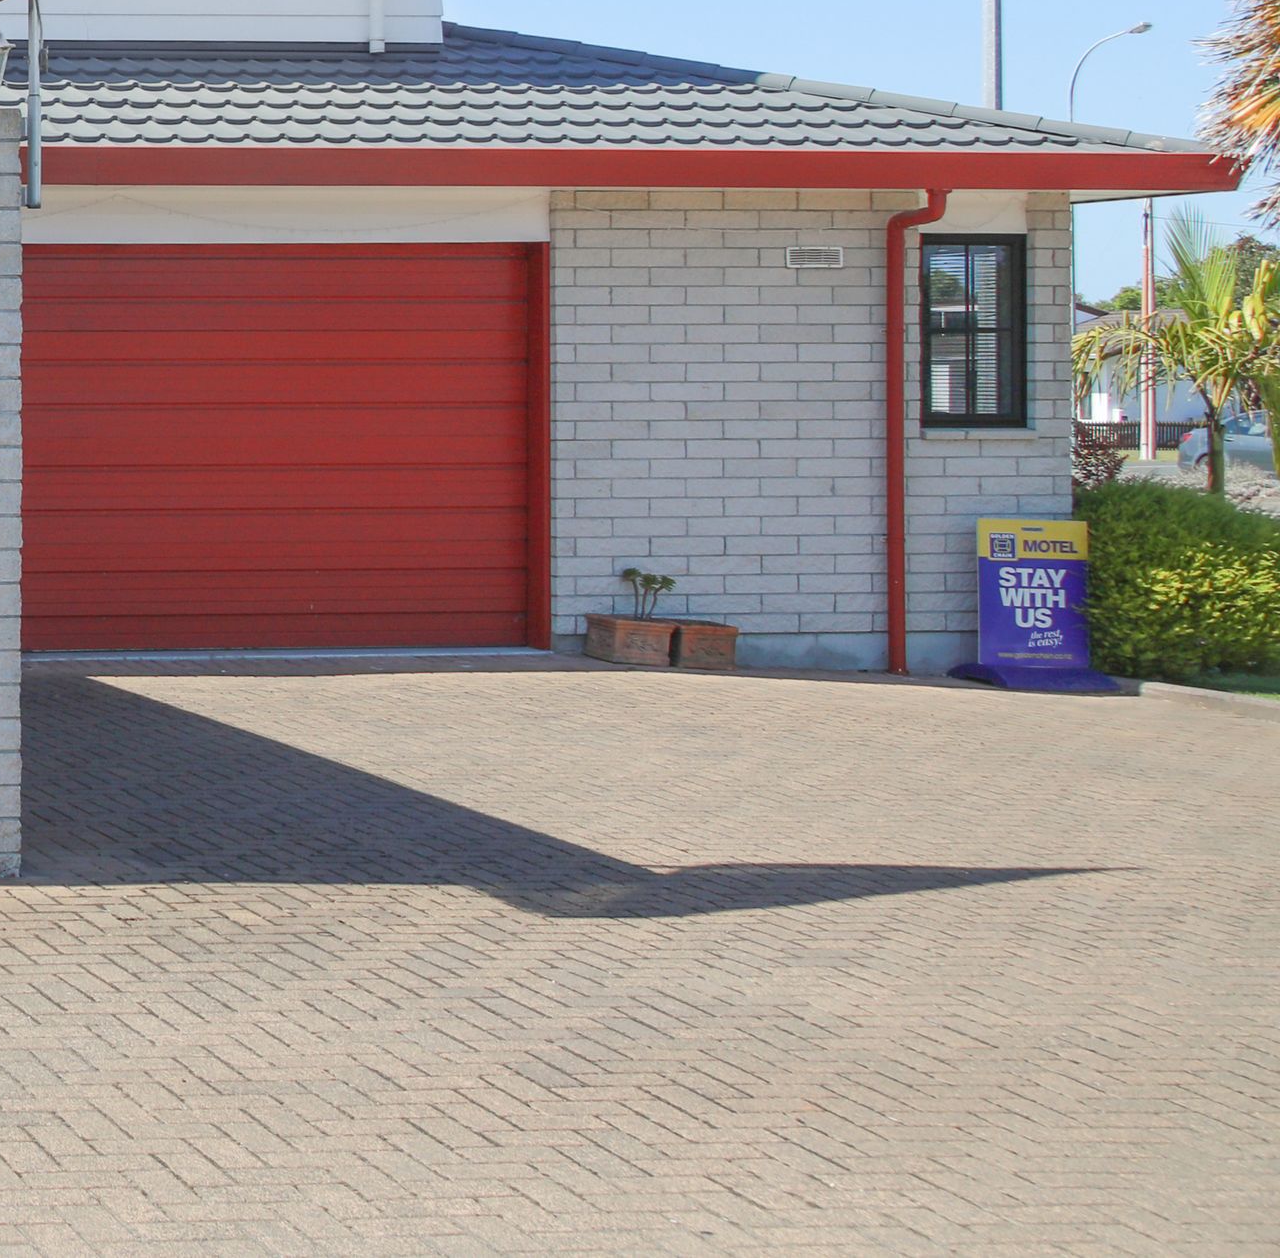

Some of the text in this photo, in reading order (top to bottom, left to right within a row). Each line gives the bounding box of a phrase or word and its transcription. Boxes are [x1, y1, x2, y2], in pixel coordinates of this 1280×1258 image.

[1023, 539, 1078, 553] MOTEL
[998, 566, 1067, 588] STAY
[999, 587, 1066, 608] WITH
[1015, 608, 1053, 629] US
[1030, 631, 1042, 639] the
